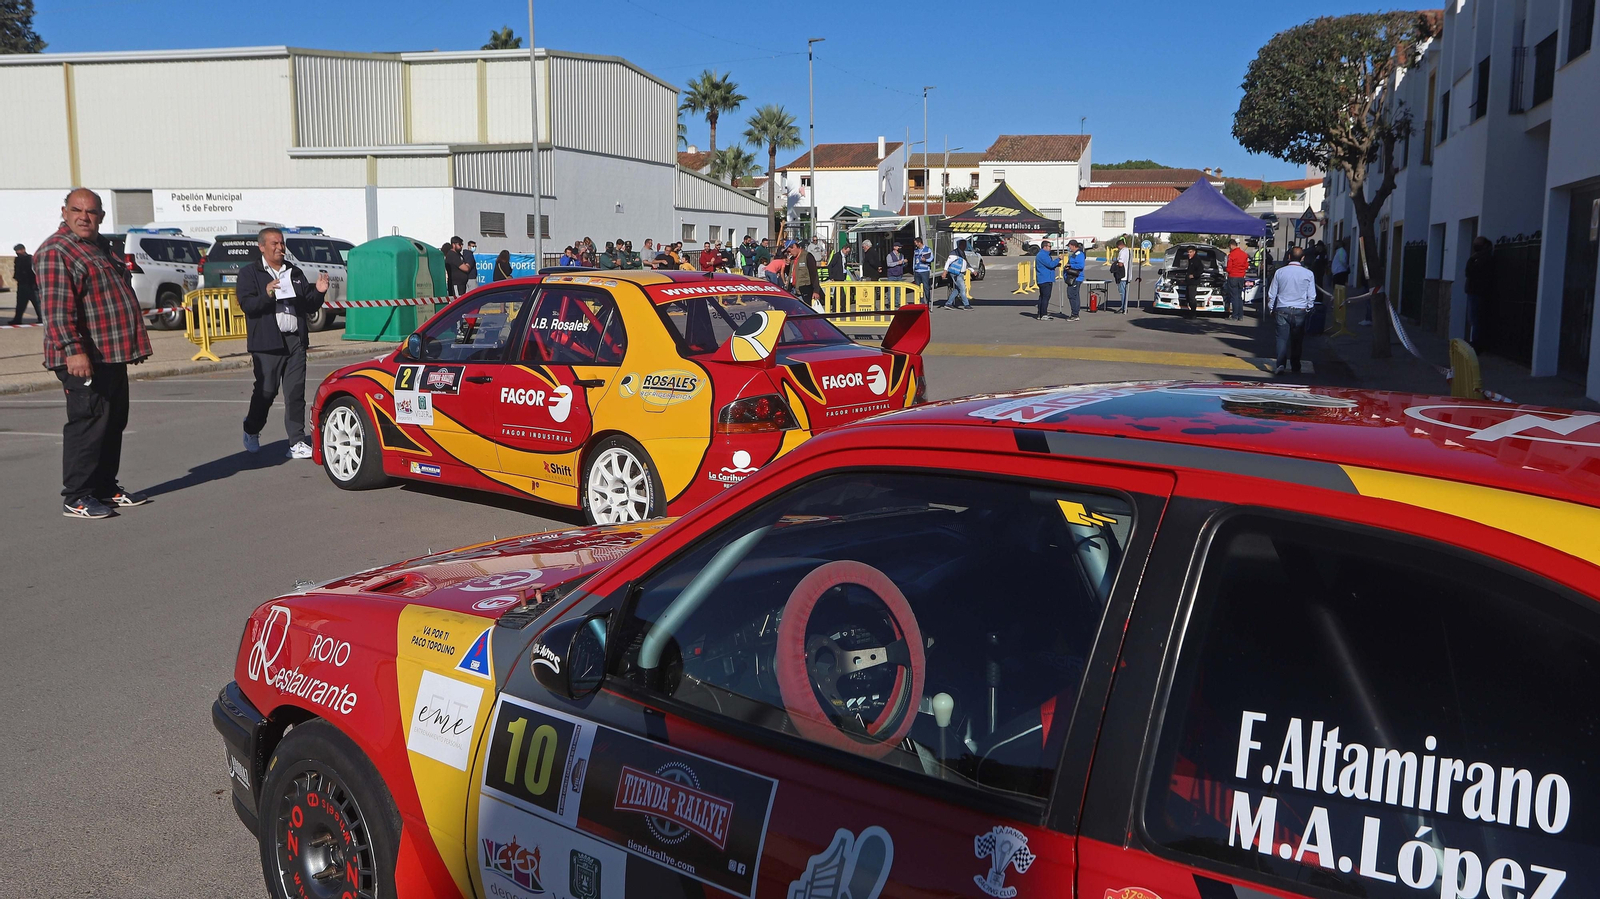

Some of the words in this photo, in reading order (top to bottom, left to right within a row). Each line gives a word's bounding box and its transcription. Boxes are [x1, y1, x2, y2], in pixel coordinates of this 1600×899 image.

[171, 193, 204, 201] Pabellón
[206, 193, 243, 203] Municipal
[182, 204, 191, 212] 15
[192, 204, 202, 212] de
[203, 204, 233, 212] Febrero
[660, 283, 782, 297] www.rosales.es
[532, 317, 549, 330] J.B.
[551, 319, 589, 332] Rosales
[400, 368, 412, 388] 2
[643, 375, 697, 391] ROSALES
[821, 372, 865, 390] FAGOR
[500, 387, 546, 407] FAGOR
[826, 409, 849, 418] FAGOR
[852, 404, 890, 413] INDUSTRIAL
[502, 428, 526, 437] FAGOR
[529, 431, 573, 443] INDUSTRIAL
[550, 462, 572, 477] Shift
[709, 471, 717, 479] La
[423, 626, 432, 636] VA
[431, 628, 444, 639] POR
[444, 631, 450, 641] TI
[309, 634, 351, 667] ROIO
[411, 635, 427, 648] PACO
[427, 640, 456, 656] TOPOLINO
[248, 605, 358, 714] Restaurante
[418, 705, 472, 736] eme
[504, 716, 558, 796] 10
[1234, 710, 1571, 834] F.Altamirano
[622, 773, 671, 812] TIENDA
[674, 791, 728, 840] RALLYE
[995, 828, 1004, 836] LA
[1004, 828, 1028, 844] JANDA
[1228, 790, 1567, 899] M.A.López
[627, 839, 696, 873] tiendarallye.com
[977, 876, 999, 896] RACING
[999, 888, 1017, 898] CLUB
